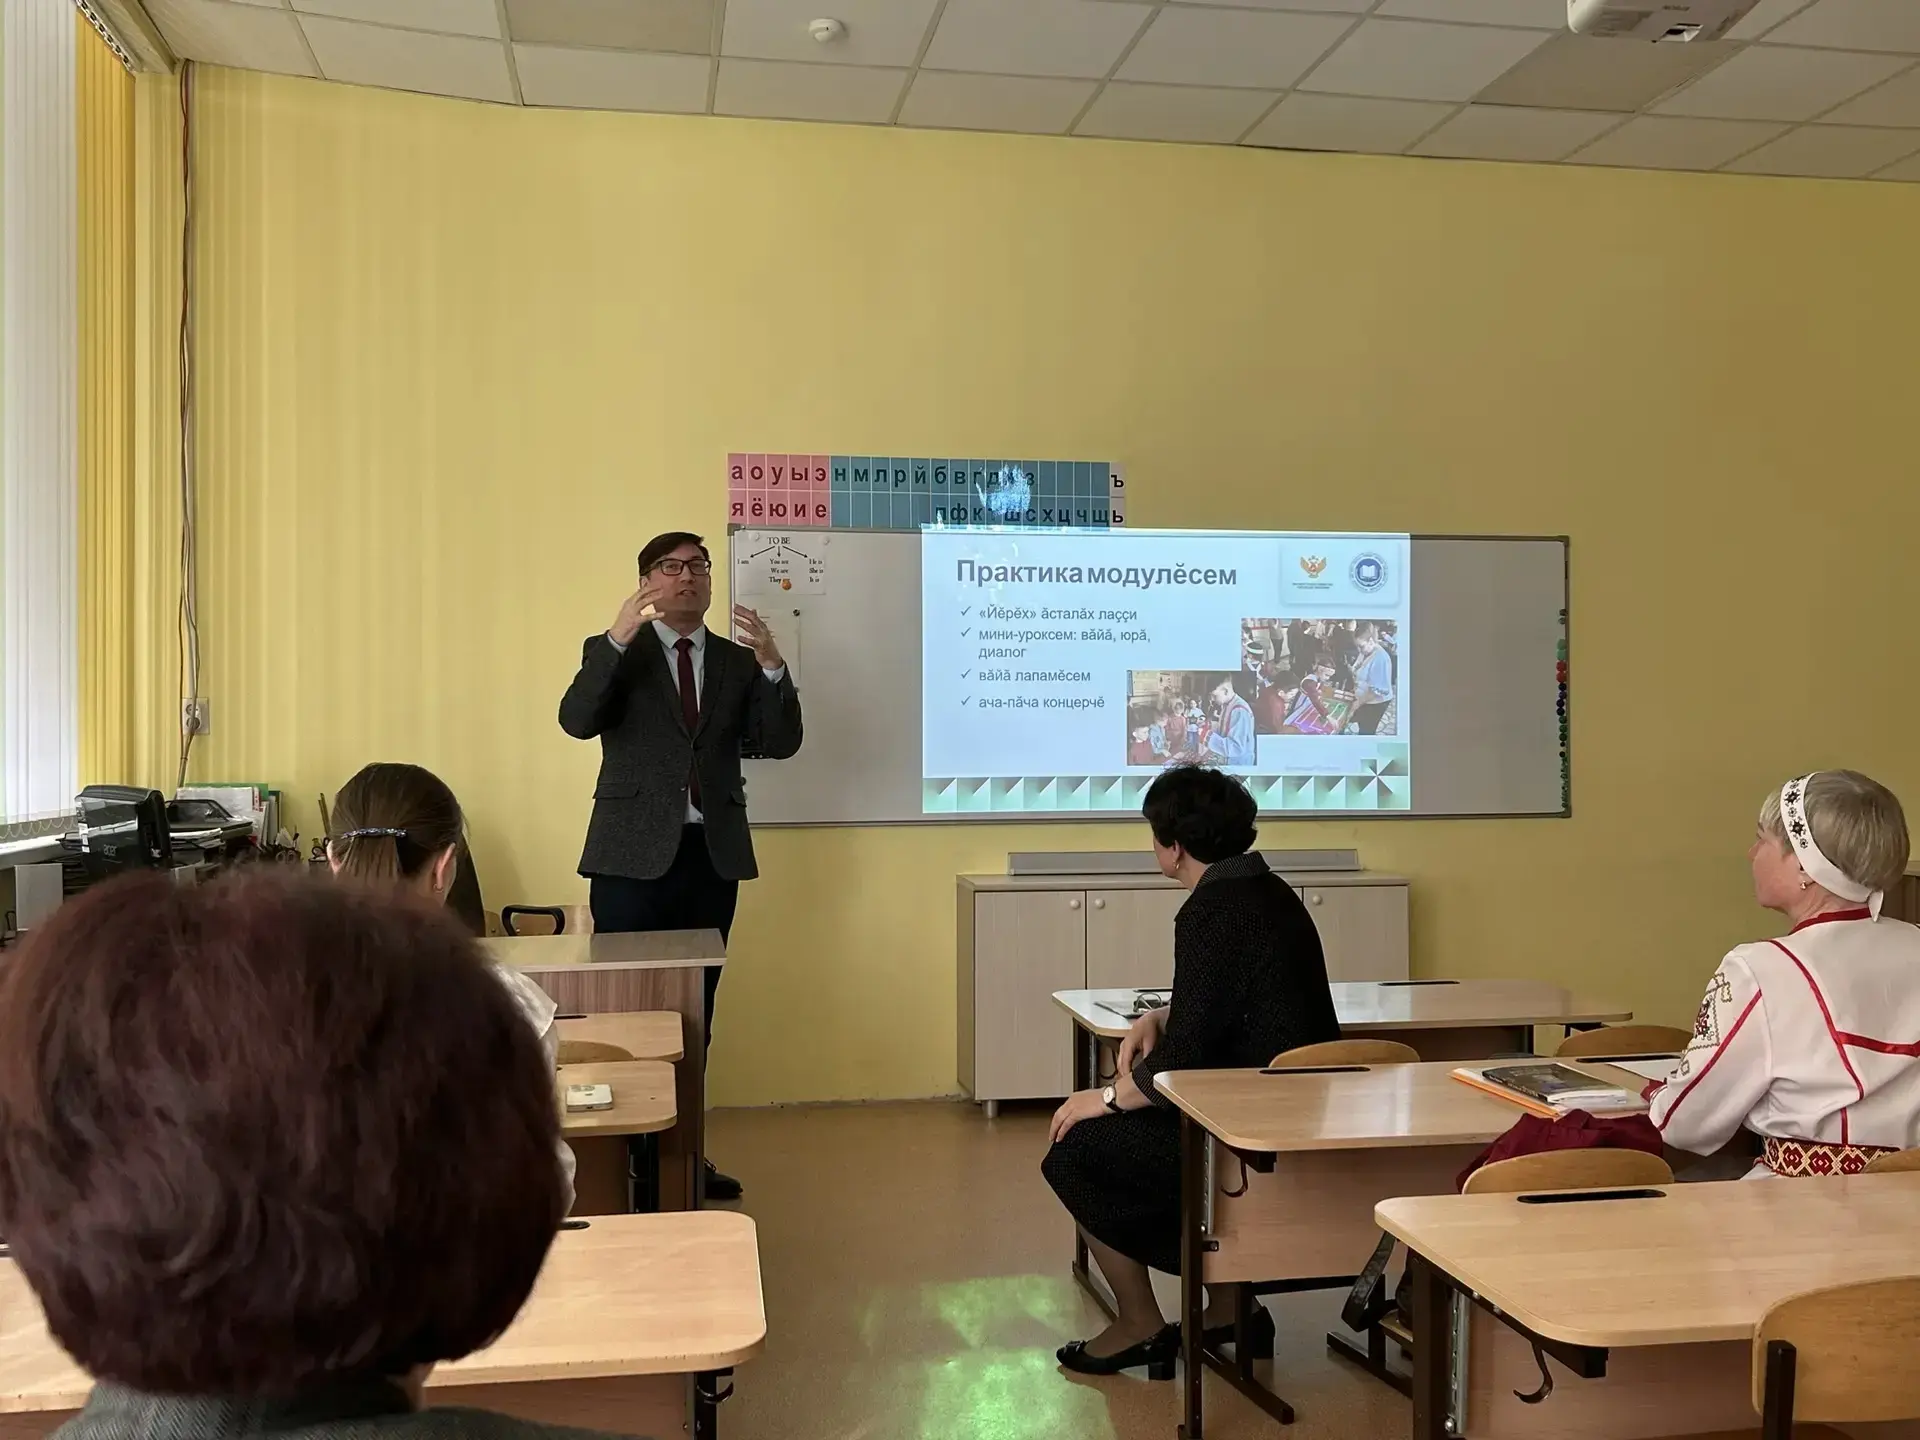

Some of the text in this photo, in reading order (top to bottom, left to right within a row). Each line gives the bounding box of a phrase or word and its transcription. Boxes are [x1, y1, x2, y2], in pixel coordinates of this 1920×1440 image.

[767, 536, 791, 545] TO BE
[957, 559, 1083, 587] Практика
[979, 630, 1077, 643] мини-уроксем:
[978, 647, 1027, 659] диалог
